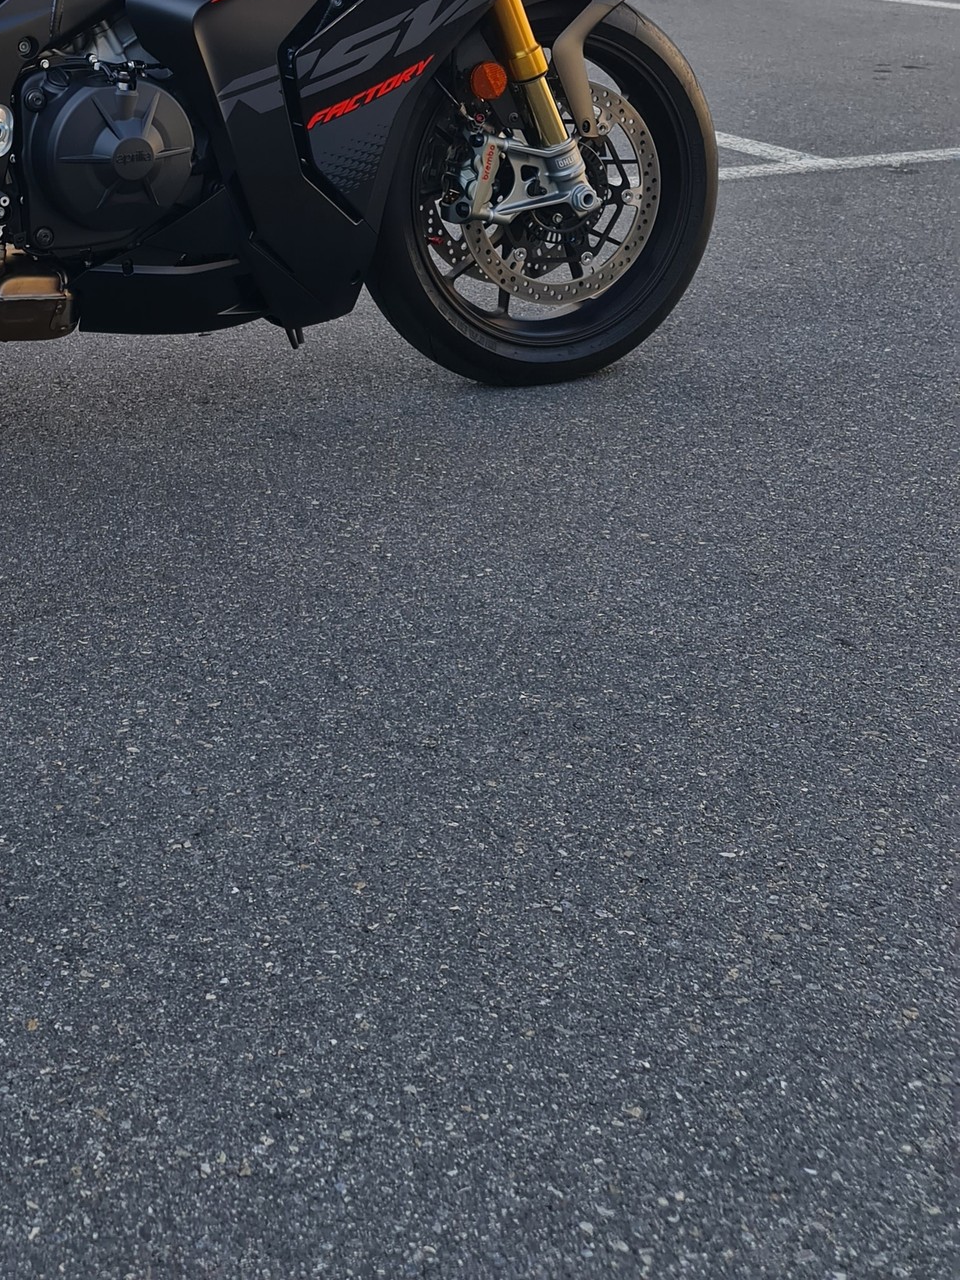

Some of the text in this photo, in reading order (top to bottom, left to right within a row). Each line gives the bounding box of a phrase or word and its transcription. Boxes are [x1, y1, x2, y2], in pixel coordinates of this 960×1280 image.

[306, 54, 435, 131] FACTORY
[115, 150, 151, 166] aprilia
[481, 144, 496, 182] brembo
